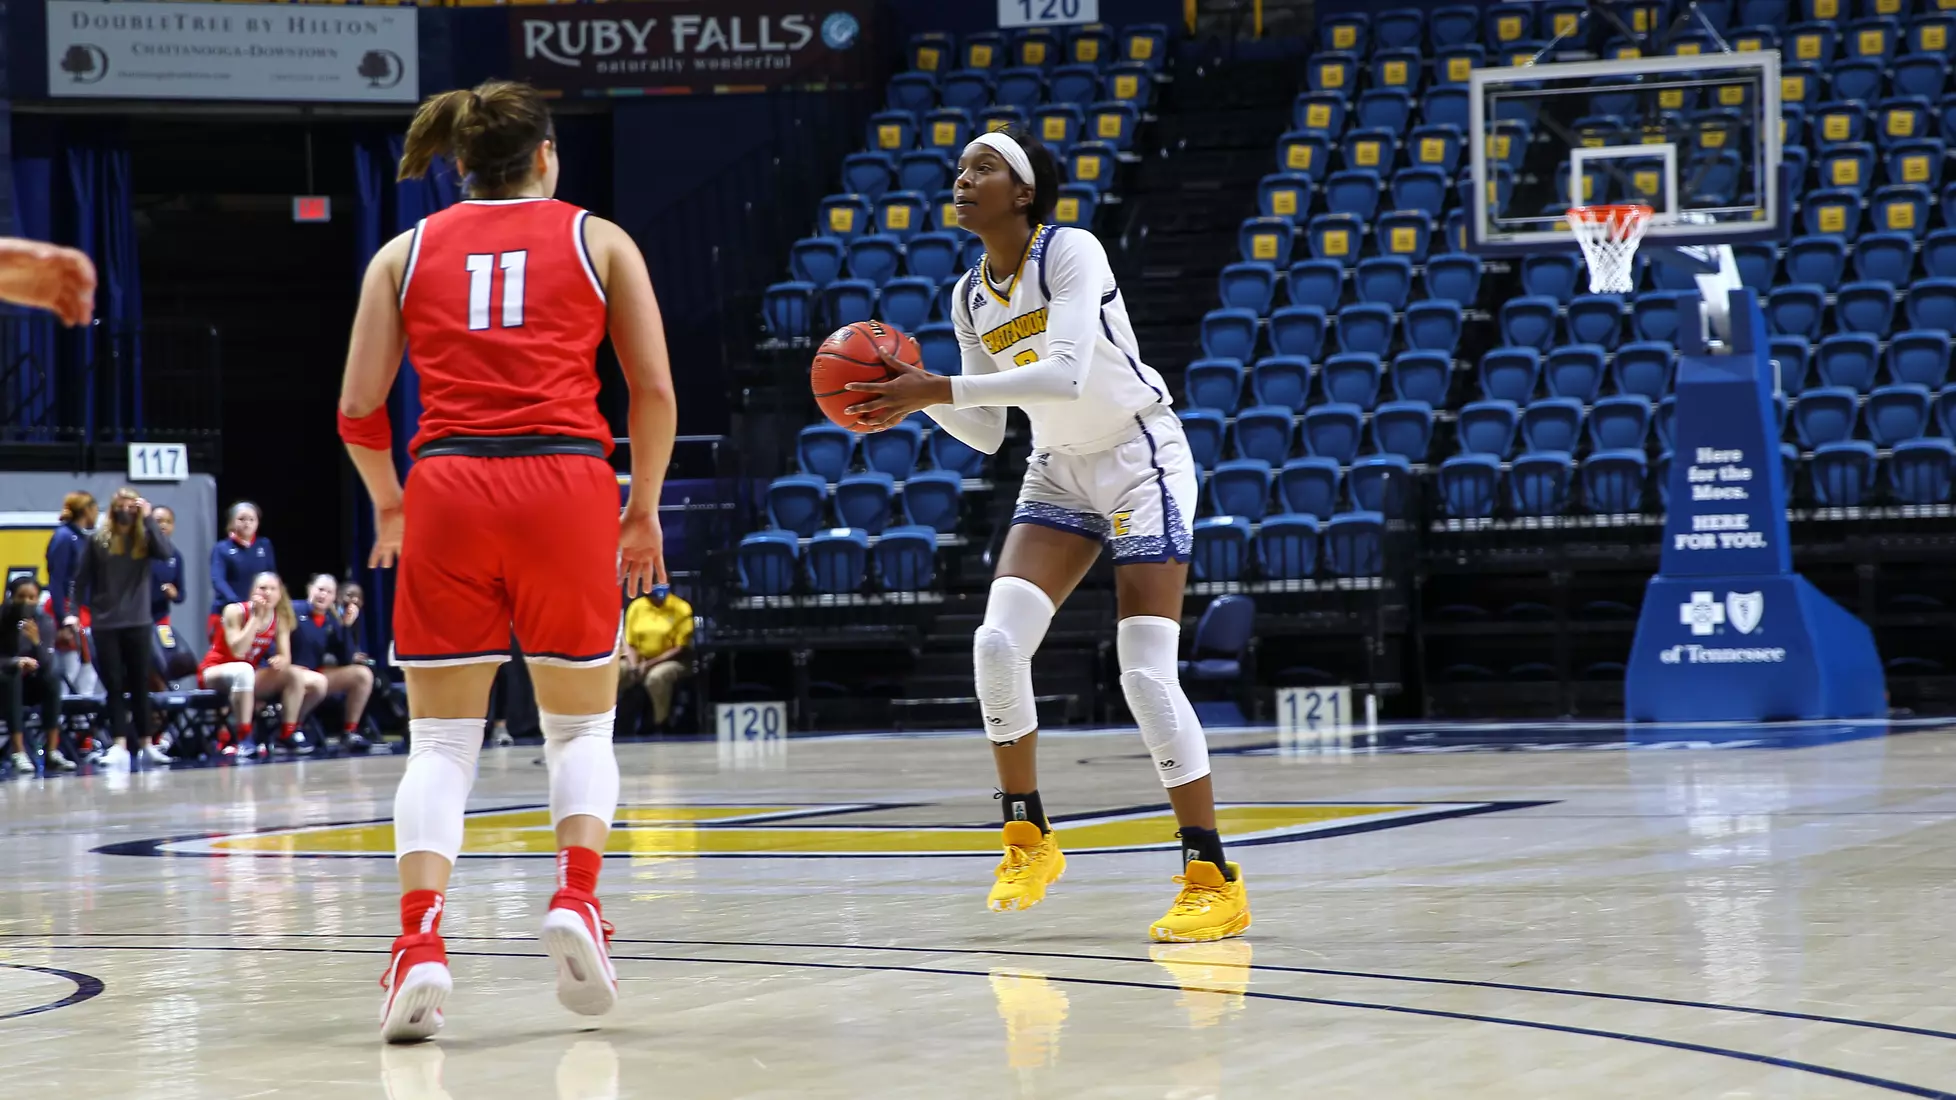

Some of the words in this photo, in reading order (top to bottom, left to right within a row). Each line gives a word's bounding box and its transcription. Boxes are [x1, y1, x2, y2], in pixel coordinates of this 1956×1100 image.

[1018, 0, 1080, 21] 120
[246, 17, 273, 33] BY
[288, 16, 378, 35] HILTON
[523, 19, 658, 67] RUBY
[671, 14, 814, 51] FALLS
[597, 56, 685, 74] naturally
[694, 54, 792, 70] wonderful
[465, 248, 528, 331] 11
[137, 447, 179, 475] 117
[1696, 447, 1743, 463] Here
[1688, 465, 1717, 482] for
[1719, 465, 1752, 481] the
[1692, 514, 1749, 531] HERE
[1674, 533, 1717, 550] FOR
[1719, 532, 1767, 549] YOU.
[1660, 644, 1684, 664] of
[1684, 644, 1785, 663] Tennessee
[1285, 690, 1341, 722] 121
[723, 706, 779, 736] 120
